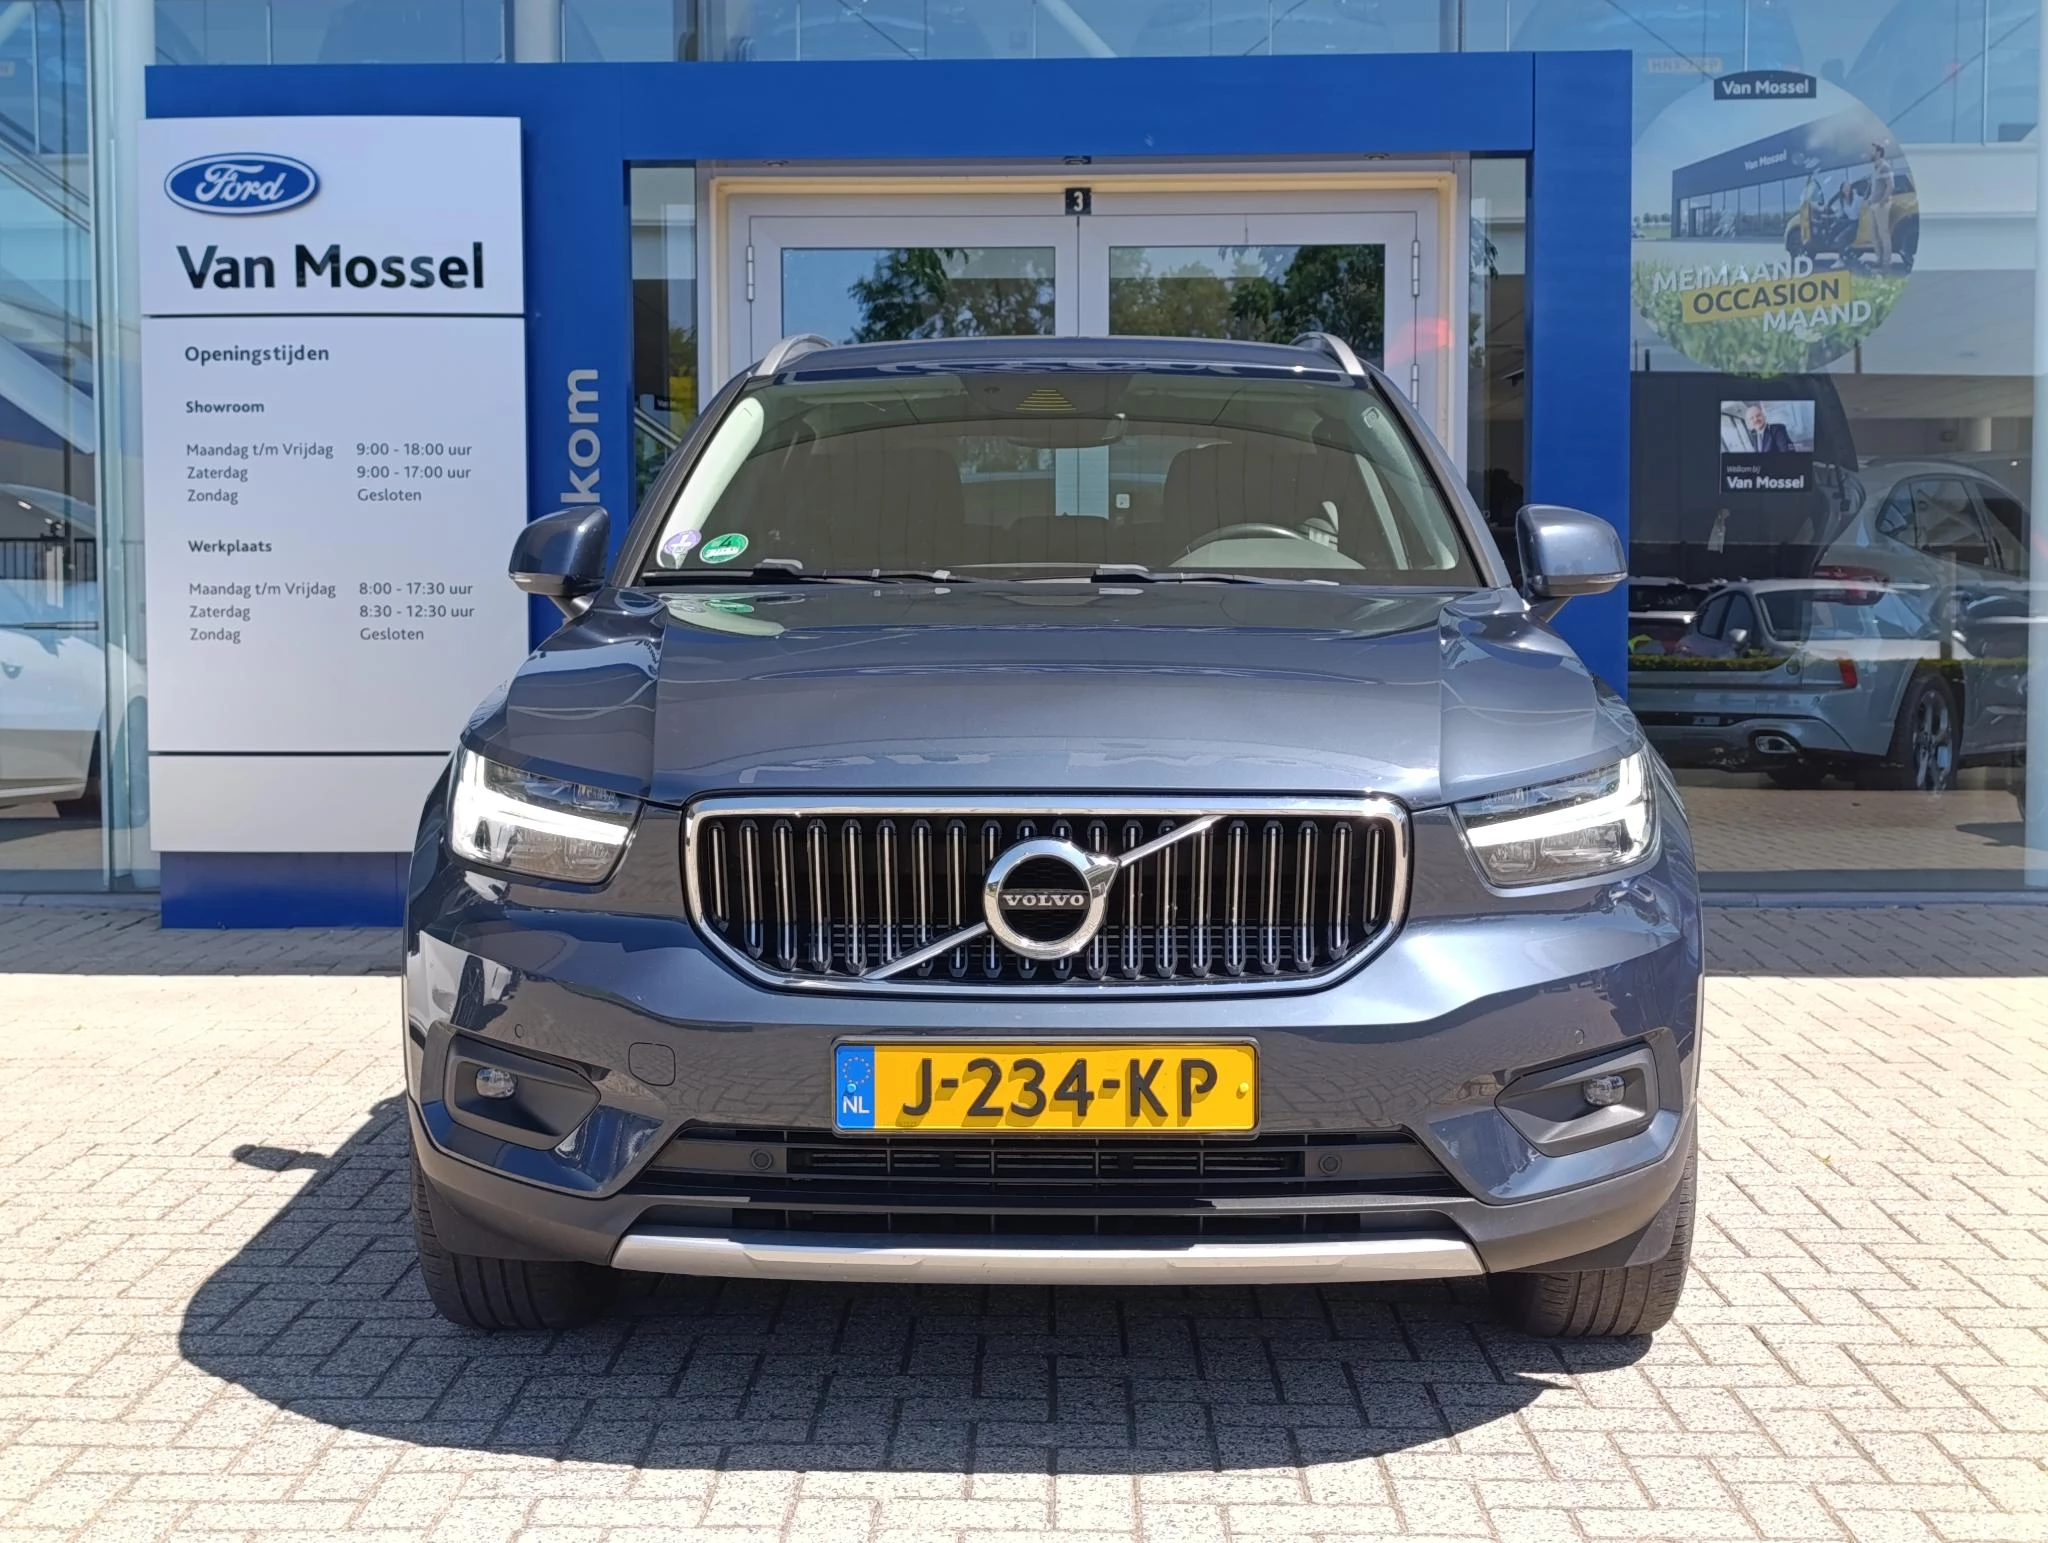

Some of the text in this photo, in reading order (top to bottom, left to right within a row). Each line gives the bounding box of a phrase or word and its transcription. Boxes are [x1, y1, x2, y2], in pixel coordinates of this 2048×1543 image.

[1722, 79, 1809, 96] Van Mossel
[195, 162, 287, 202] Ford
[1073, 191, 1084, 212] 3
[176, 241, 485, 290] Van Mossel
[1651, 255, 1814, 294] MEIMAAND
[1692, 277, 1841, 315] OCCASION
[1762, 300, 1872, 333] MAAND
[184, 345, 330, 367] Openingstijden
[185, 401, 265, 413] Showroom
[186, 442, 334, 459] Maandag t/m Vrijdag
[356, 443, 389, 456] 9:00
[404, 443, 444, 456] 18:00
[448, 445, 472, 456] uur
[187, 466, 248, 482] Zaterdag
[357, 466, 390, 478] 9:00
[404, 465, 443, 478] 17:00
[447, 468, 471, 478] uur
[1727, 475, 1804, 489] Van Mossel
[187, 489, 238, 505] Zondag
[357, 488, 422, 501] Gesloten
[188, 540, 272, 556] Werkplaats
[189, 581, 336, 598] Maandag t/m Vrijdag
[359, 582, 392, 595] 8:00
[406, 582, 445, 595] 17:30
[449, 585, 473, 595] uur
[189, 605, 251, 621] Zaterdag
[359, 605, 392, 617] 8:30
[406, 605, 446, 618] 12:30
[451, 607, 475, 617] uur
[190, 628, 241, 644] Zondag
[360, 627, 424, 640] Gesloten
[1003, 894, 1085, 906] VOLVO
[902, 1057, 1218, 1117] J-234-KP
[842, 1097, 869, 1115] NL
